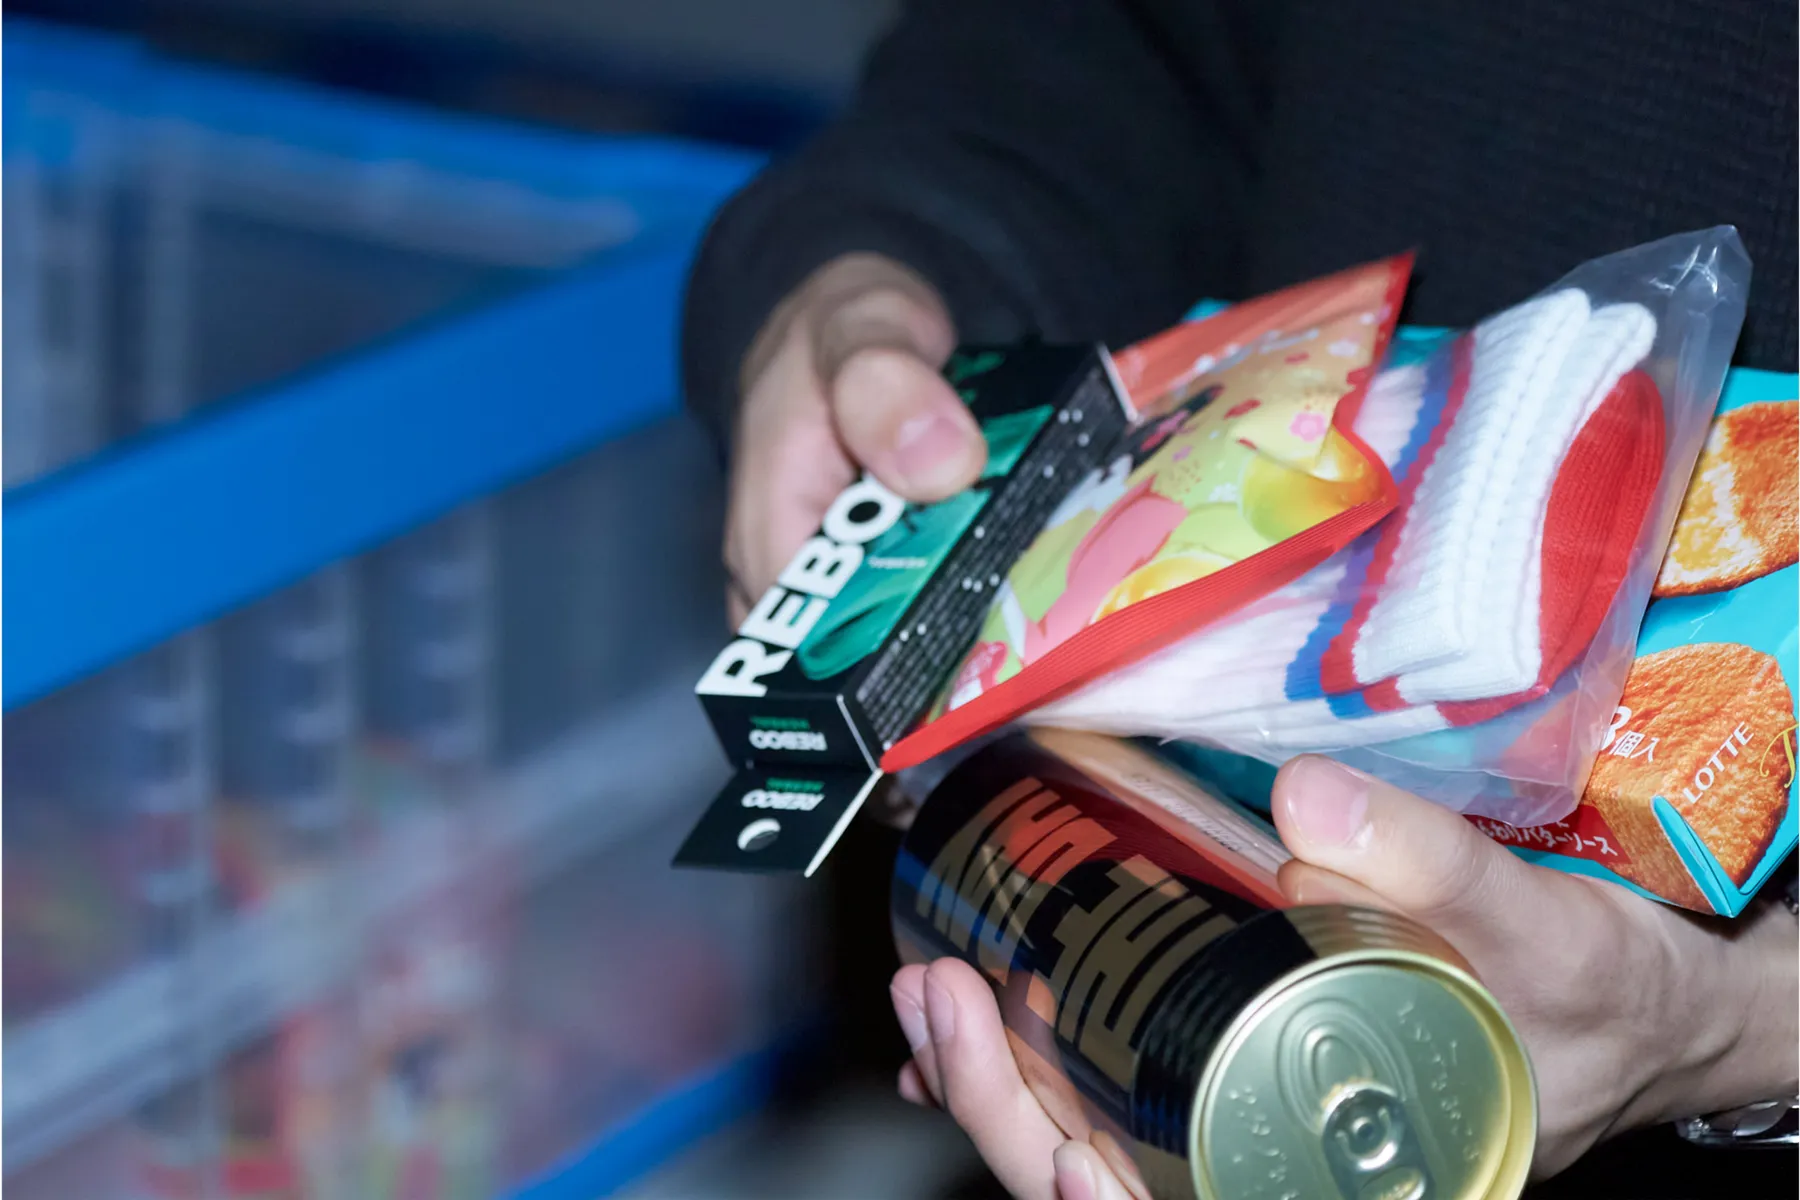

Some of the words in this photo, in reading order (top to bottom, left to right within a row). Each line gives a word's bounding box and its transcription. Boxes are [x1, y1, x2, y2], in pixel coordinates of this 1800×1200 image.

[696, 470, 906, 697] REBO
[1682, 721, 1754, 804] LOTTE
[915, 776, 1119, 987] DAY
[1025, 854, 1240, 1092] THE
